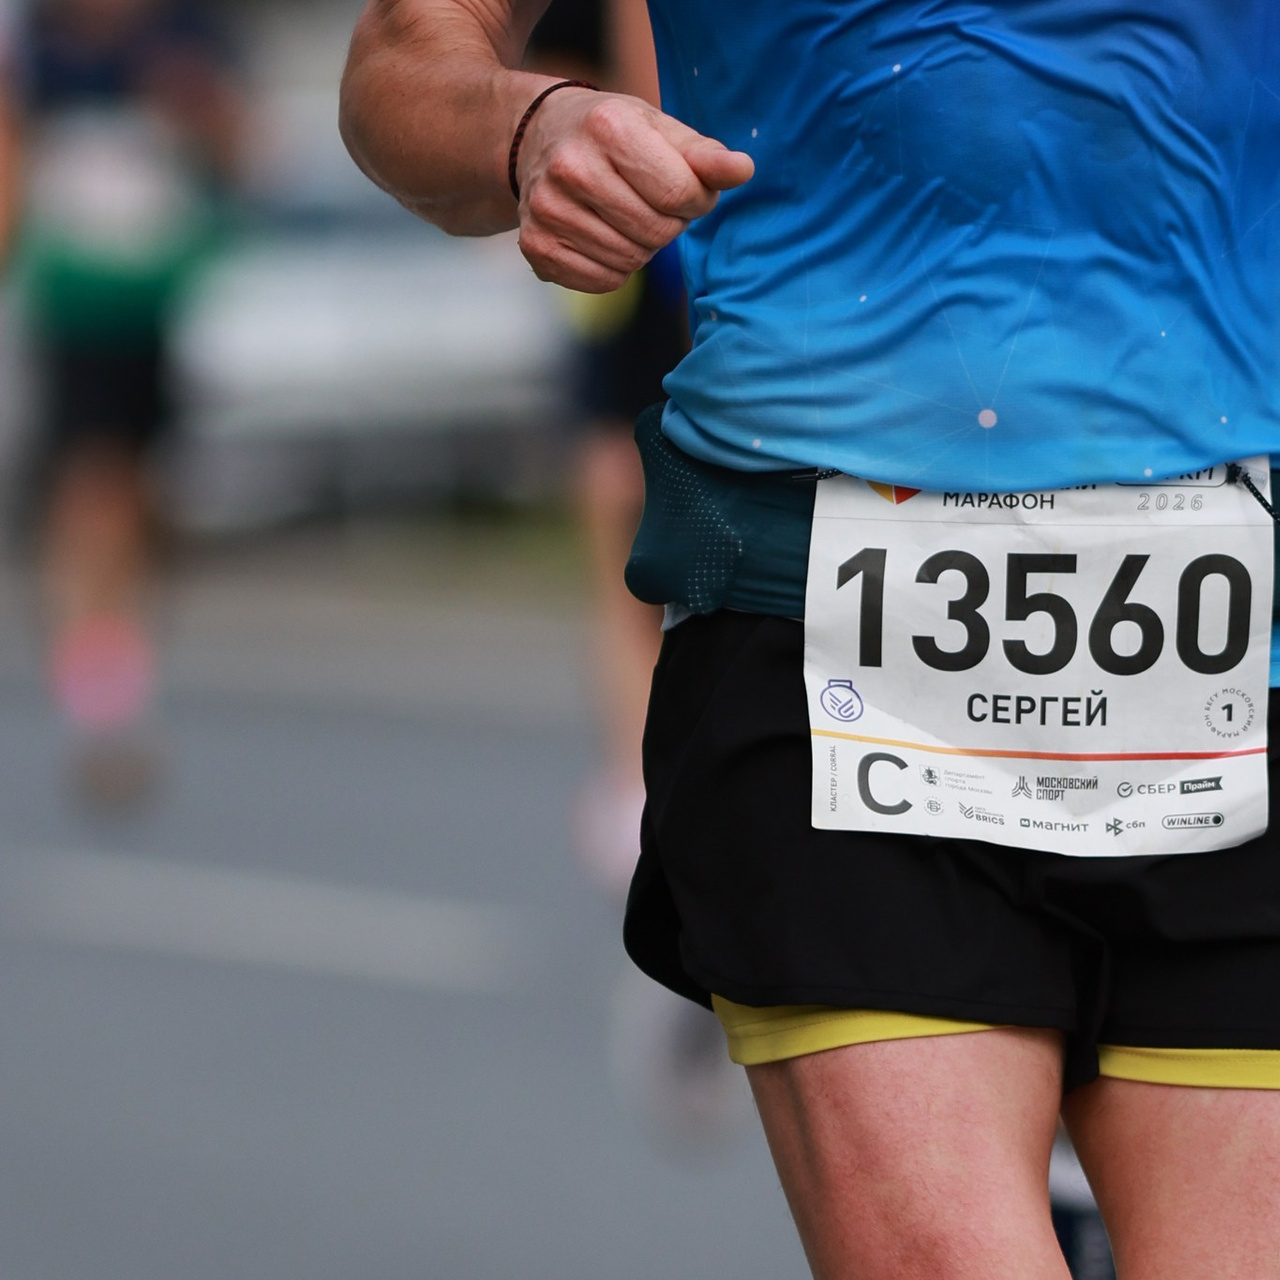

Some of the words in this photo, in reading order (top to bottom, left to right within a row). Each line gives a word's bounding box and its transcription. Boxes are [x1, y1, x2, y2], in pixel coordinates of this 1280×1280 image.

[942, 492, 1055, 510] МАРАФОН
[1137, 493, 1204, 511] 2026
[836, 547, 1253, 676] 13560
[967, 689, 1108, 727] СЕРГЕЙ
[1221, 703, 1233, 722] 1
[829, 745, 838, 771] CORRAL
[1036, 776, 1099, 790] МОСКОВСКИЙ
[1137, 783, 1177, 795] СБЕР
[1184, 780, 1217, 791] Прайм
[829, 777, 838, 812] КЛАСТЕР
[1036, 788, 1066, 801] СПОРТ
[975, 813, 1005, 826] BRICS
[1166, 816, 1211, 826] WINLINE
